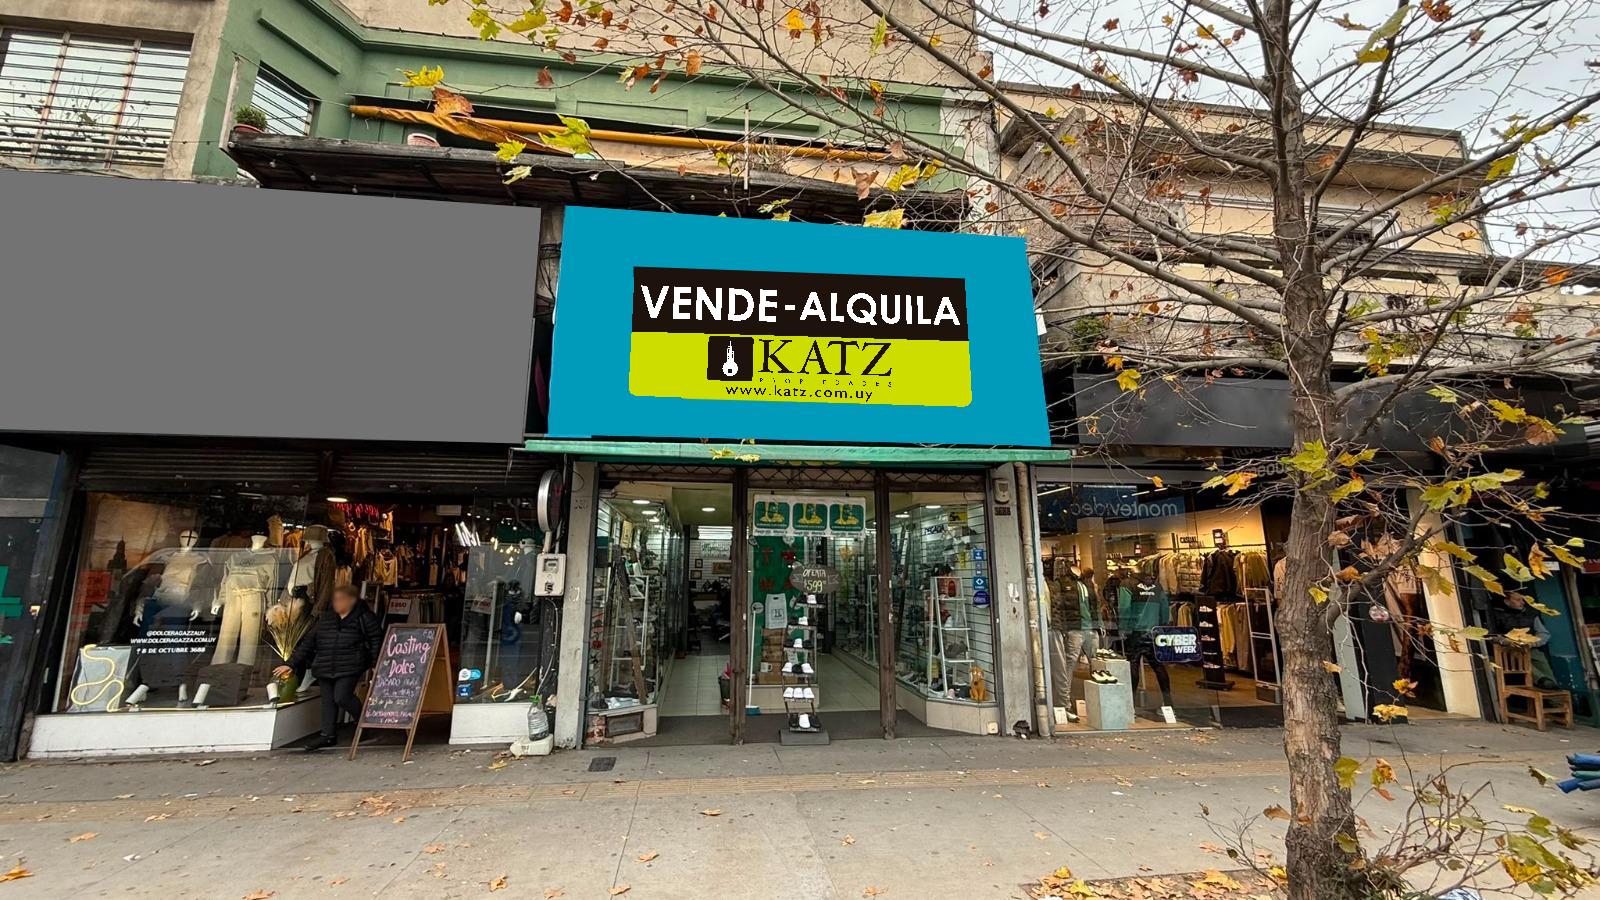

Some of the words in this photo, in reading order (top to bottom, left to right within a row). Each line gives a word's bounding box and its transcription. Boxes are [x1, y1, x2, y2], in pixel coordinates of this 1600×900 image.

[757, 338, 893, 377] KATZ
[725, 384, 873, 402] www.katz.com.uy
[803, 569, 826, 577] OFERTA
[387, 633, 431, 663] Casting
[1155, 634, 1197, 647] CYBER
[389, 659, 415, 677] Dolce
